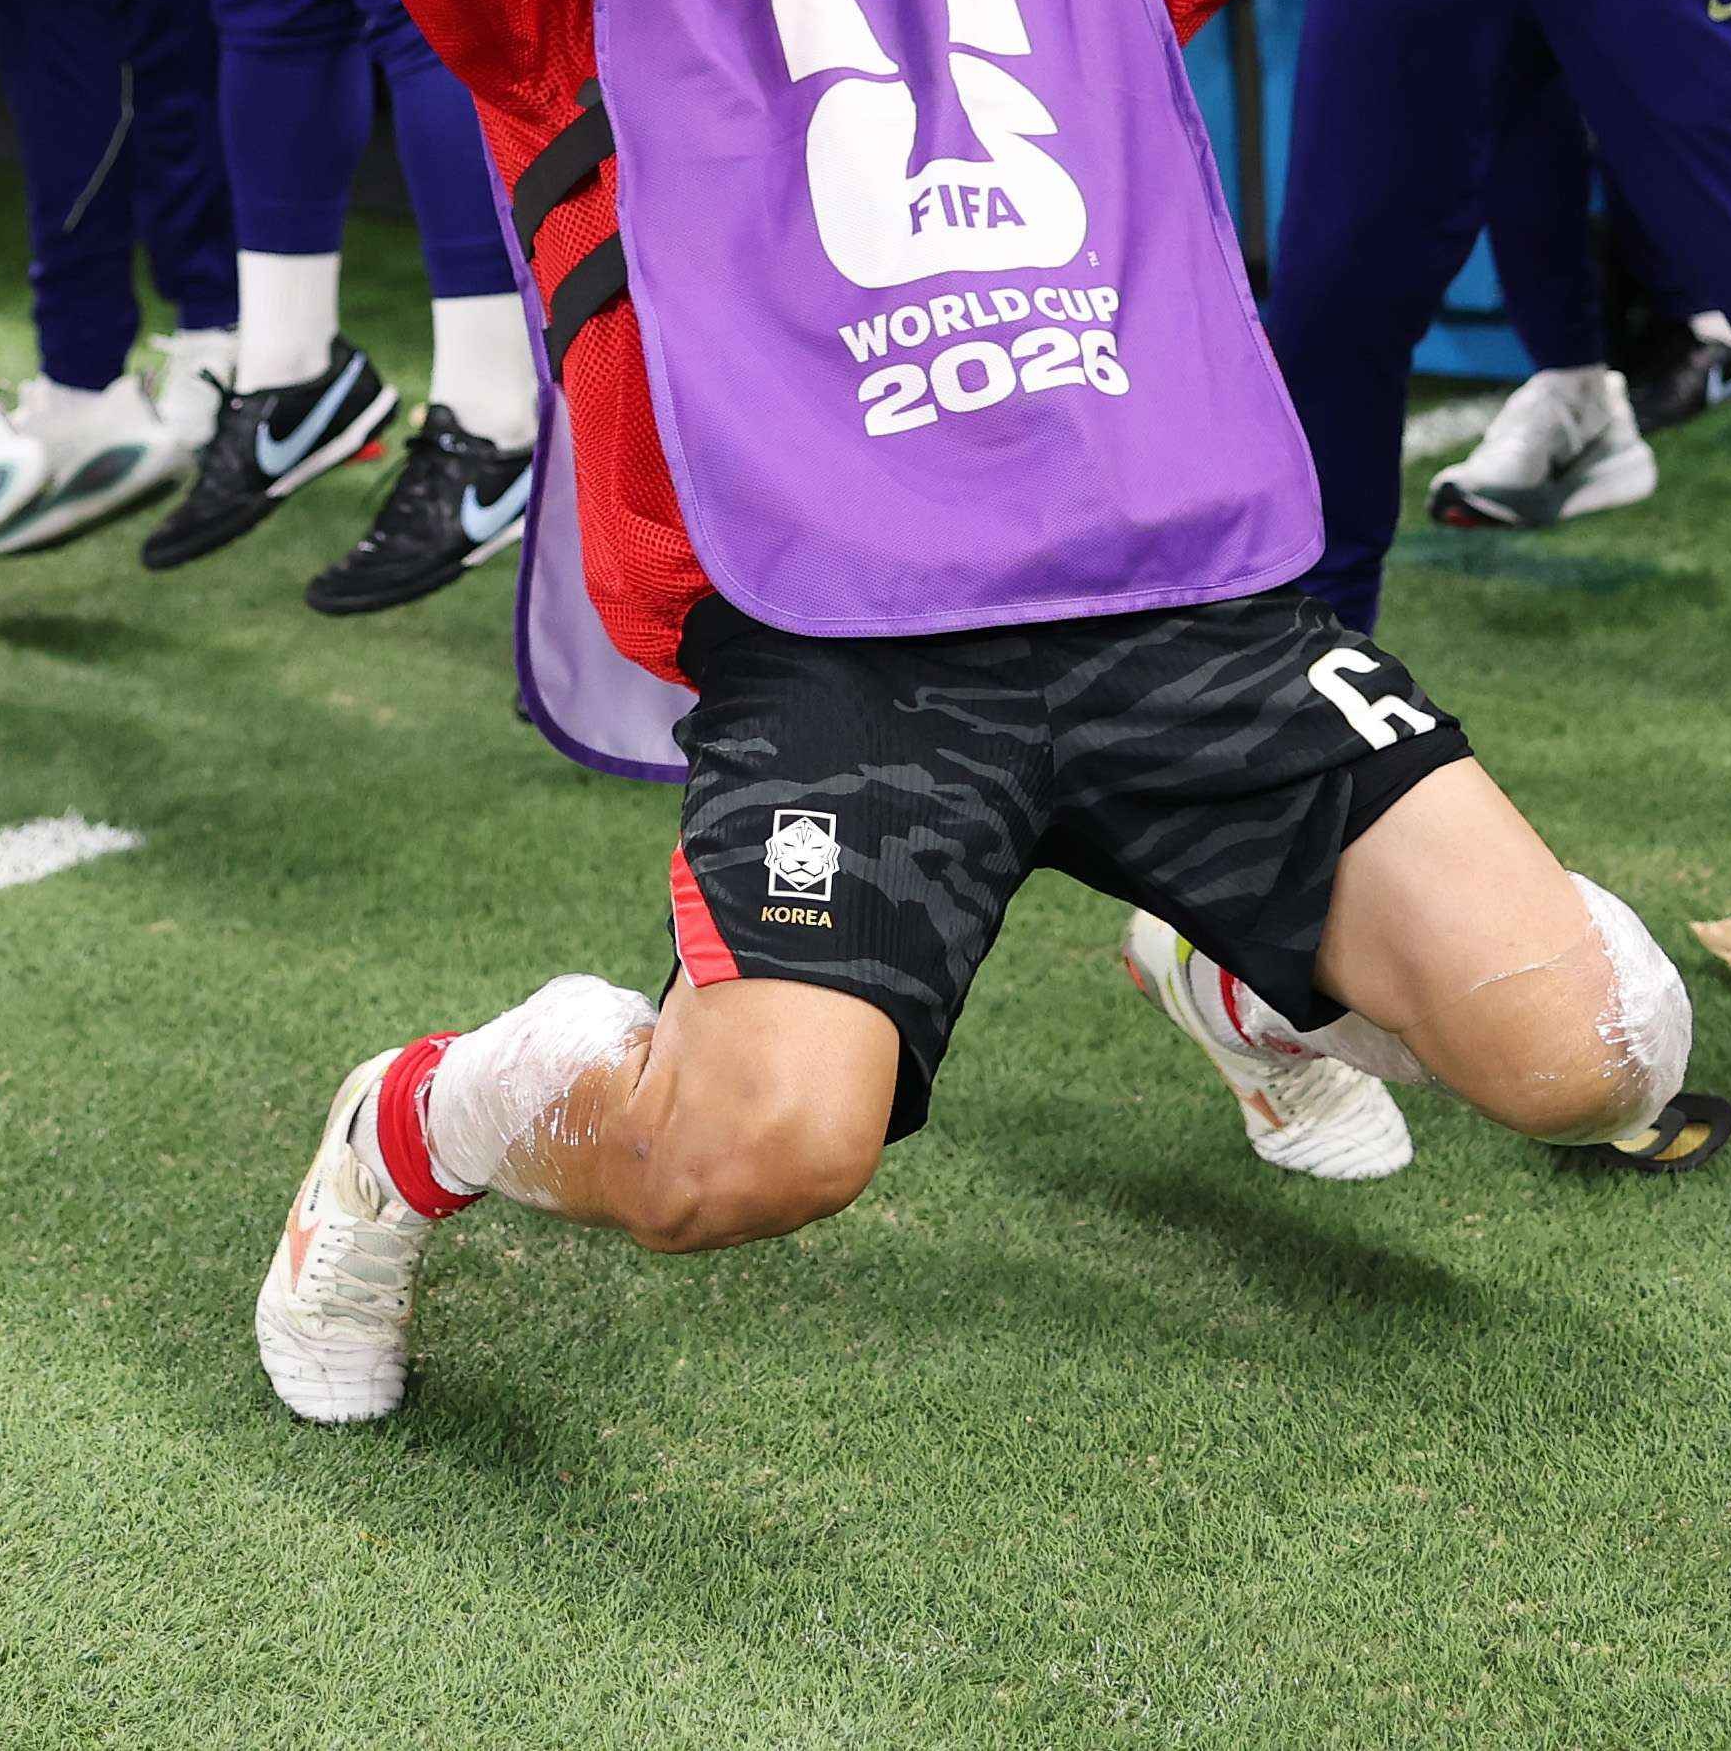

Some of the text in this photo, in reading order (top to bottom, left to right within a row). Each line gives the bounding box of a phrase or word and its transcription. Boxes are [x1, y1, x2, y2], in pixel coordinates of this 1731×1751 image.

[909, 184, 1027, 237] FIFA
[837, 285, 1119, 363] WORLD CUP
[858, 327, 1131, 437] 2026
[760, 905, 833, 929] KOREA
